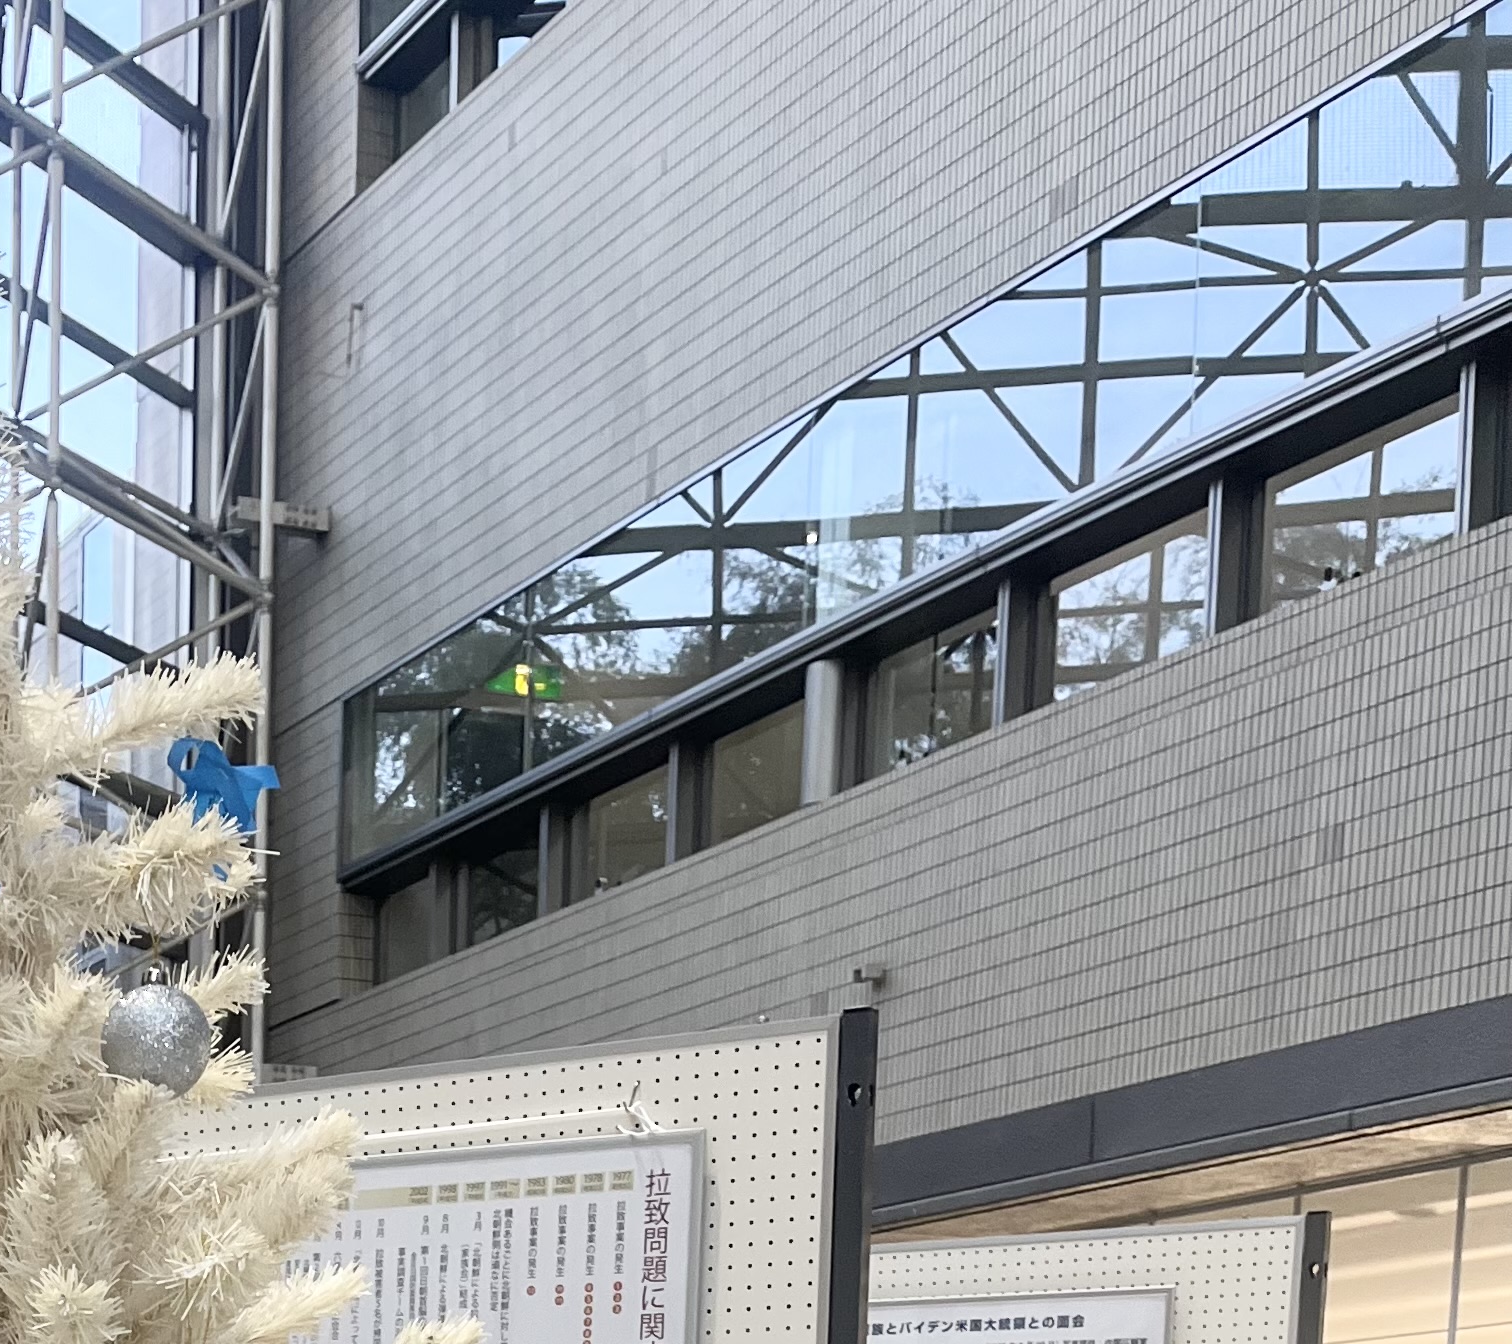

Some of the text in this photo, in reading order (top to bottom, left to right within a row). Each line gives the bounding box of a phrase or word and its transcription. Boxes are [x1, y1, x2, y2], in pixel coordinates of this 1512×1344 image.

[866, 1314, 1085, 1337] 族とバイデン米国大統領との面会
